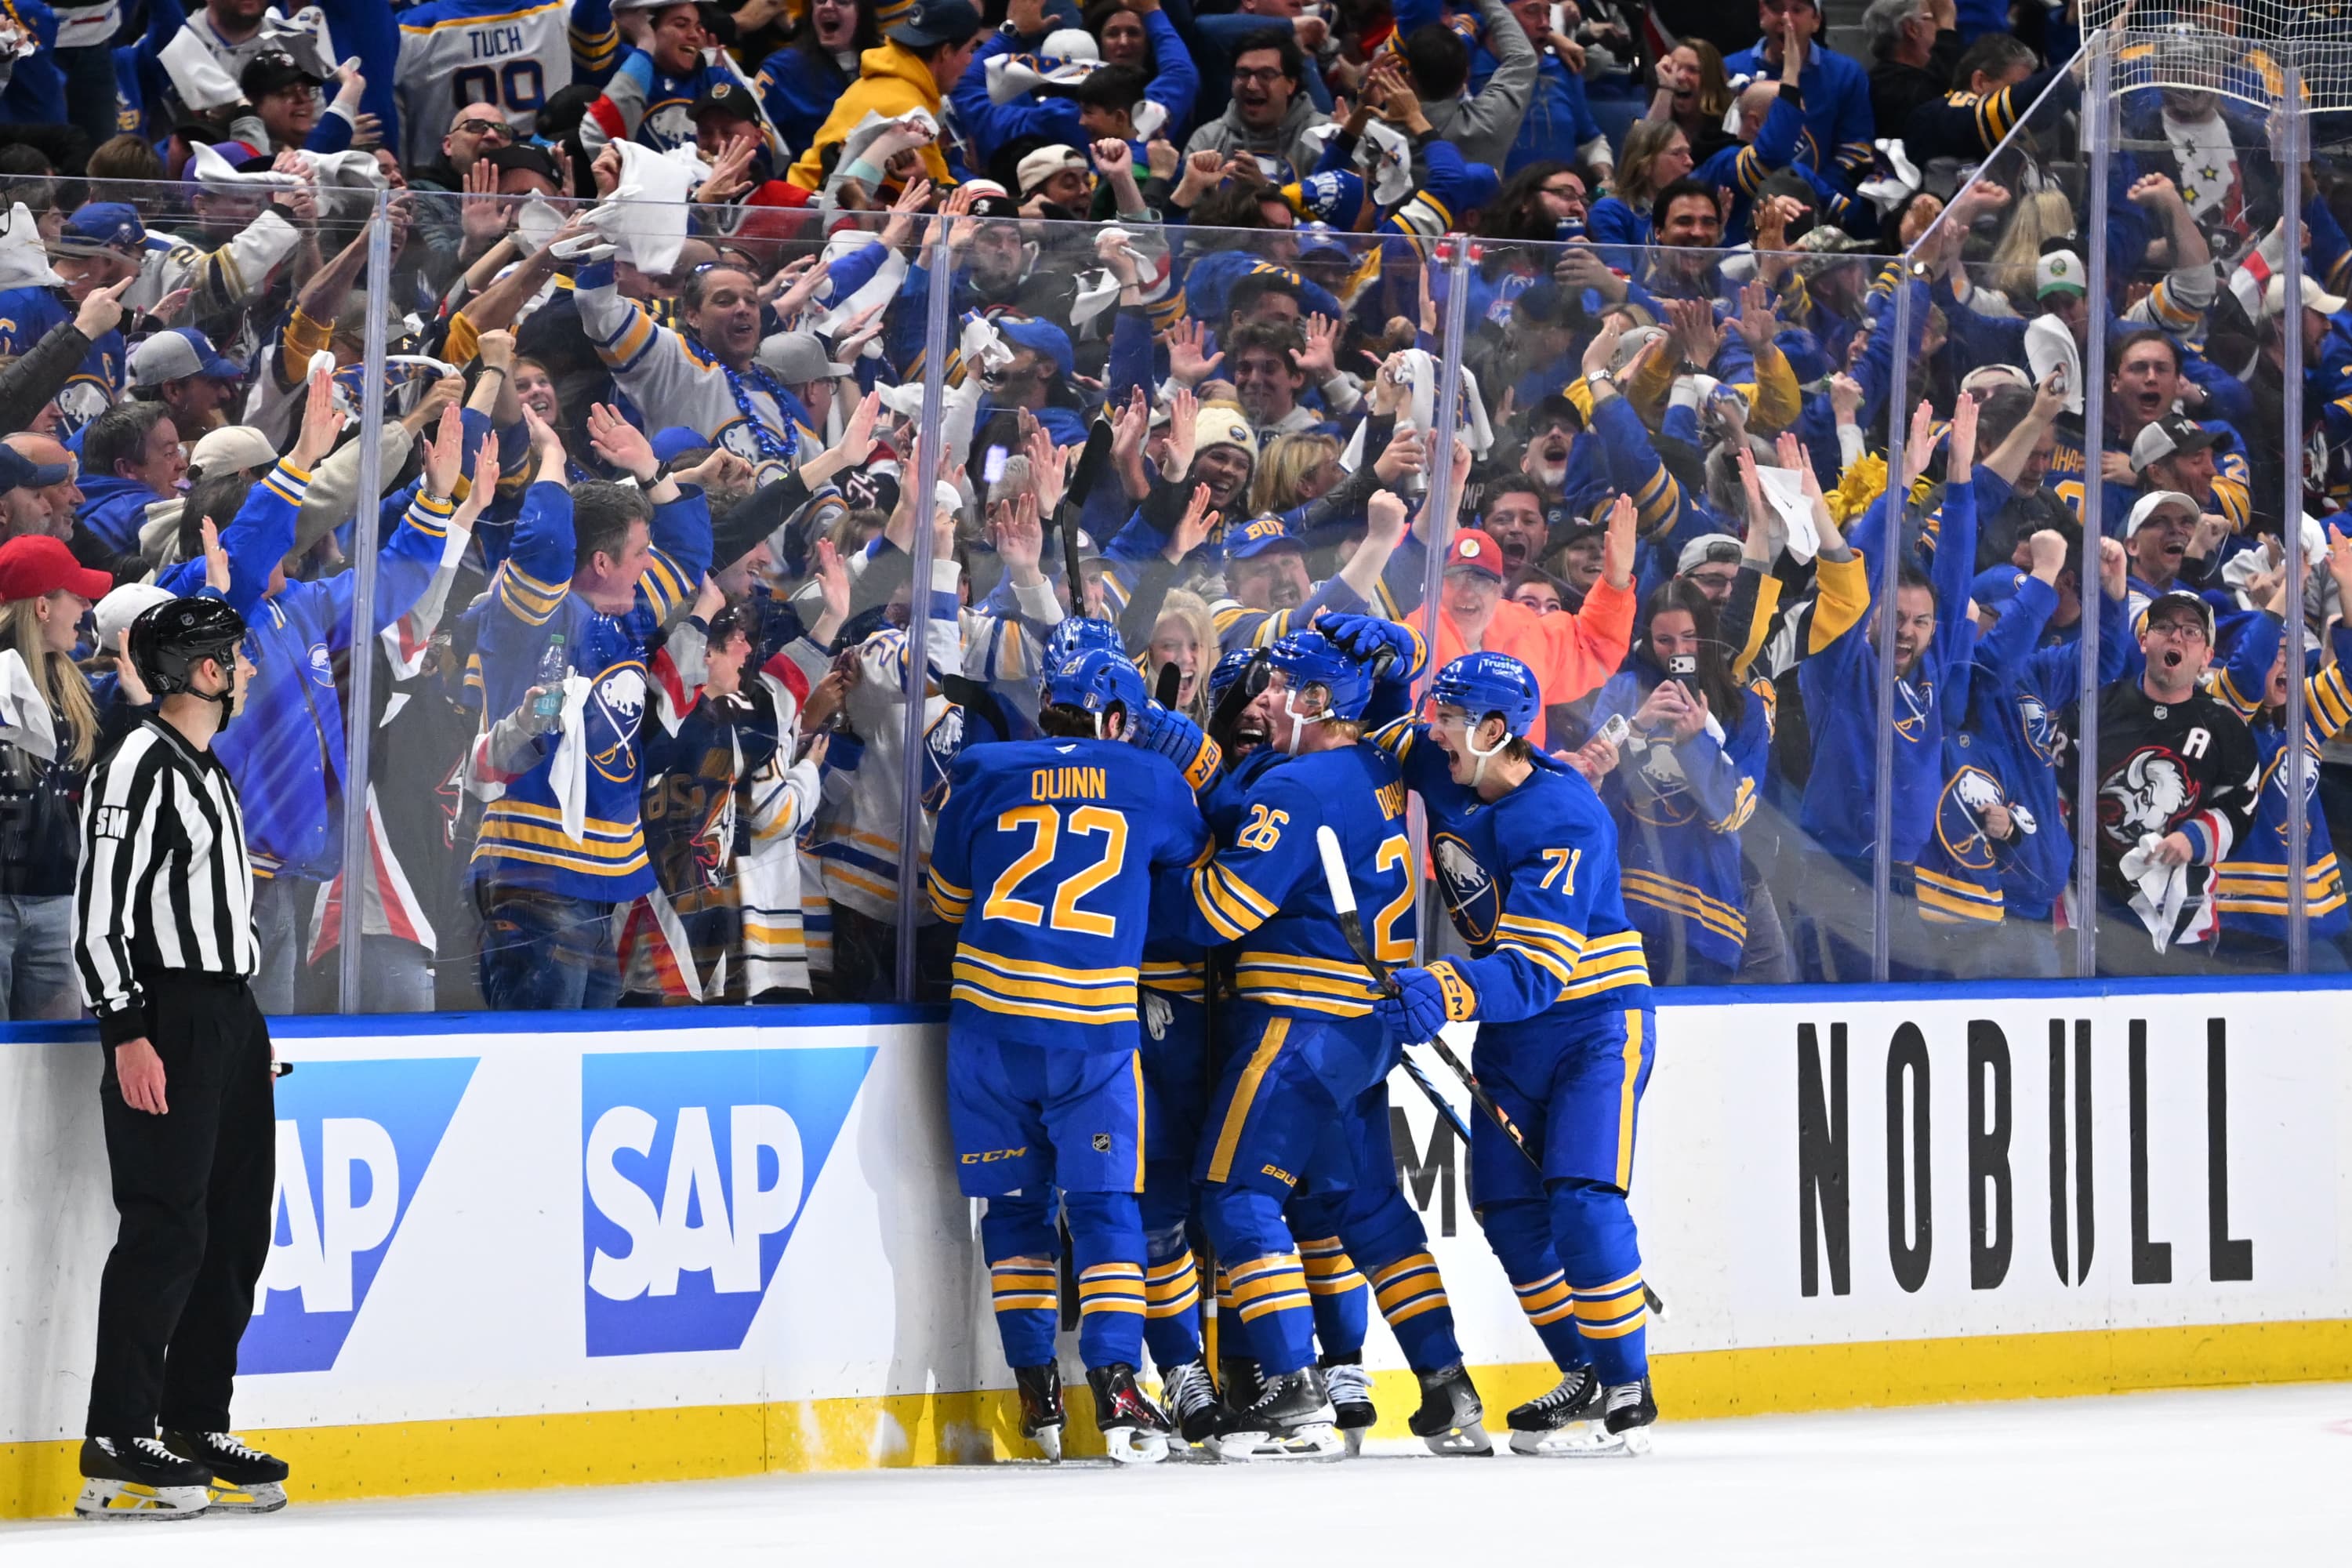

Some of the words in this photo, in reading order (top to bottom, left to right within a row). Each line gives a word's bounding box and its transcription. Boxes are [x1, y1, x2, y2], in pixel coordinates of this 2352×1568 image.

[467, 26, 524, 59] TUCH
[2182, 727, 2211, 759] A
[1031, 767, 1106, 801] QUINN
[95, 807, 129, 840] SM
[1236, 804, 1290, 852] 26
[982, 804, 1129, 938] 22
[1539, 848, 1581, 896] 71
[1429, 963, 1464, 1016] CCM
[960, 1146, 1028, 1164] CCM
[1796, 1017, 2254, 1298] NOBULL
[253, 1116, 399, 1316] AP
[586, 1104, 804, 1302] SAP
